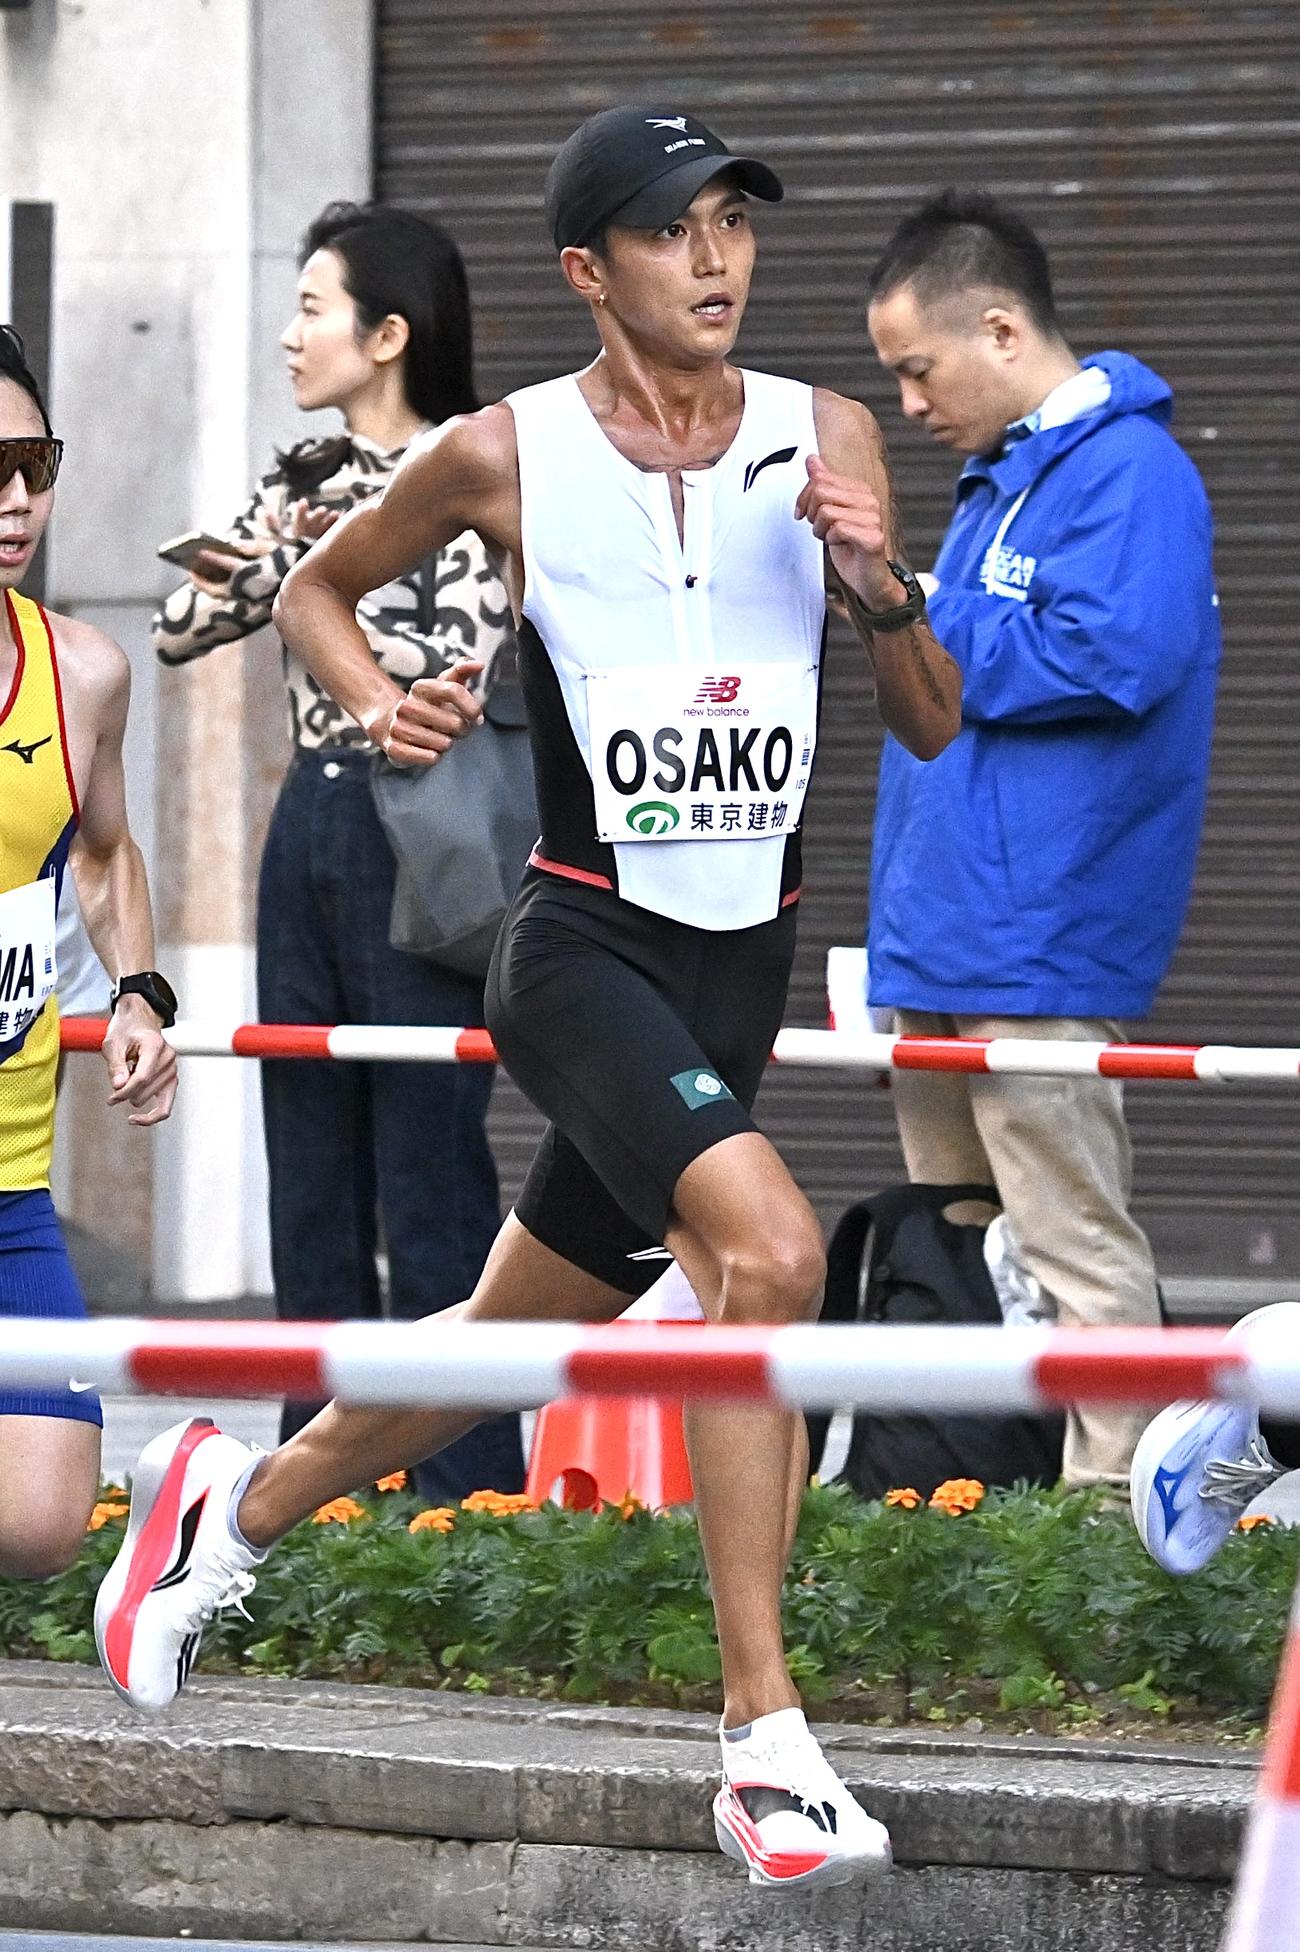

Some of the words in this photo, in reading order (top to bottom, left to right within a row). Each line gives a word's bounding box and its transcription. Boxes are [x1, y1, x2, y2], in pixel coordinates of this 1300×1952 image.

[683, 708, 704, 717] new
[707, 707, 750, 717] balance
[606, 726, 793, 795] OSAKO
[690, 801, 788, 832] 東京建物
